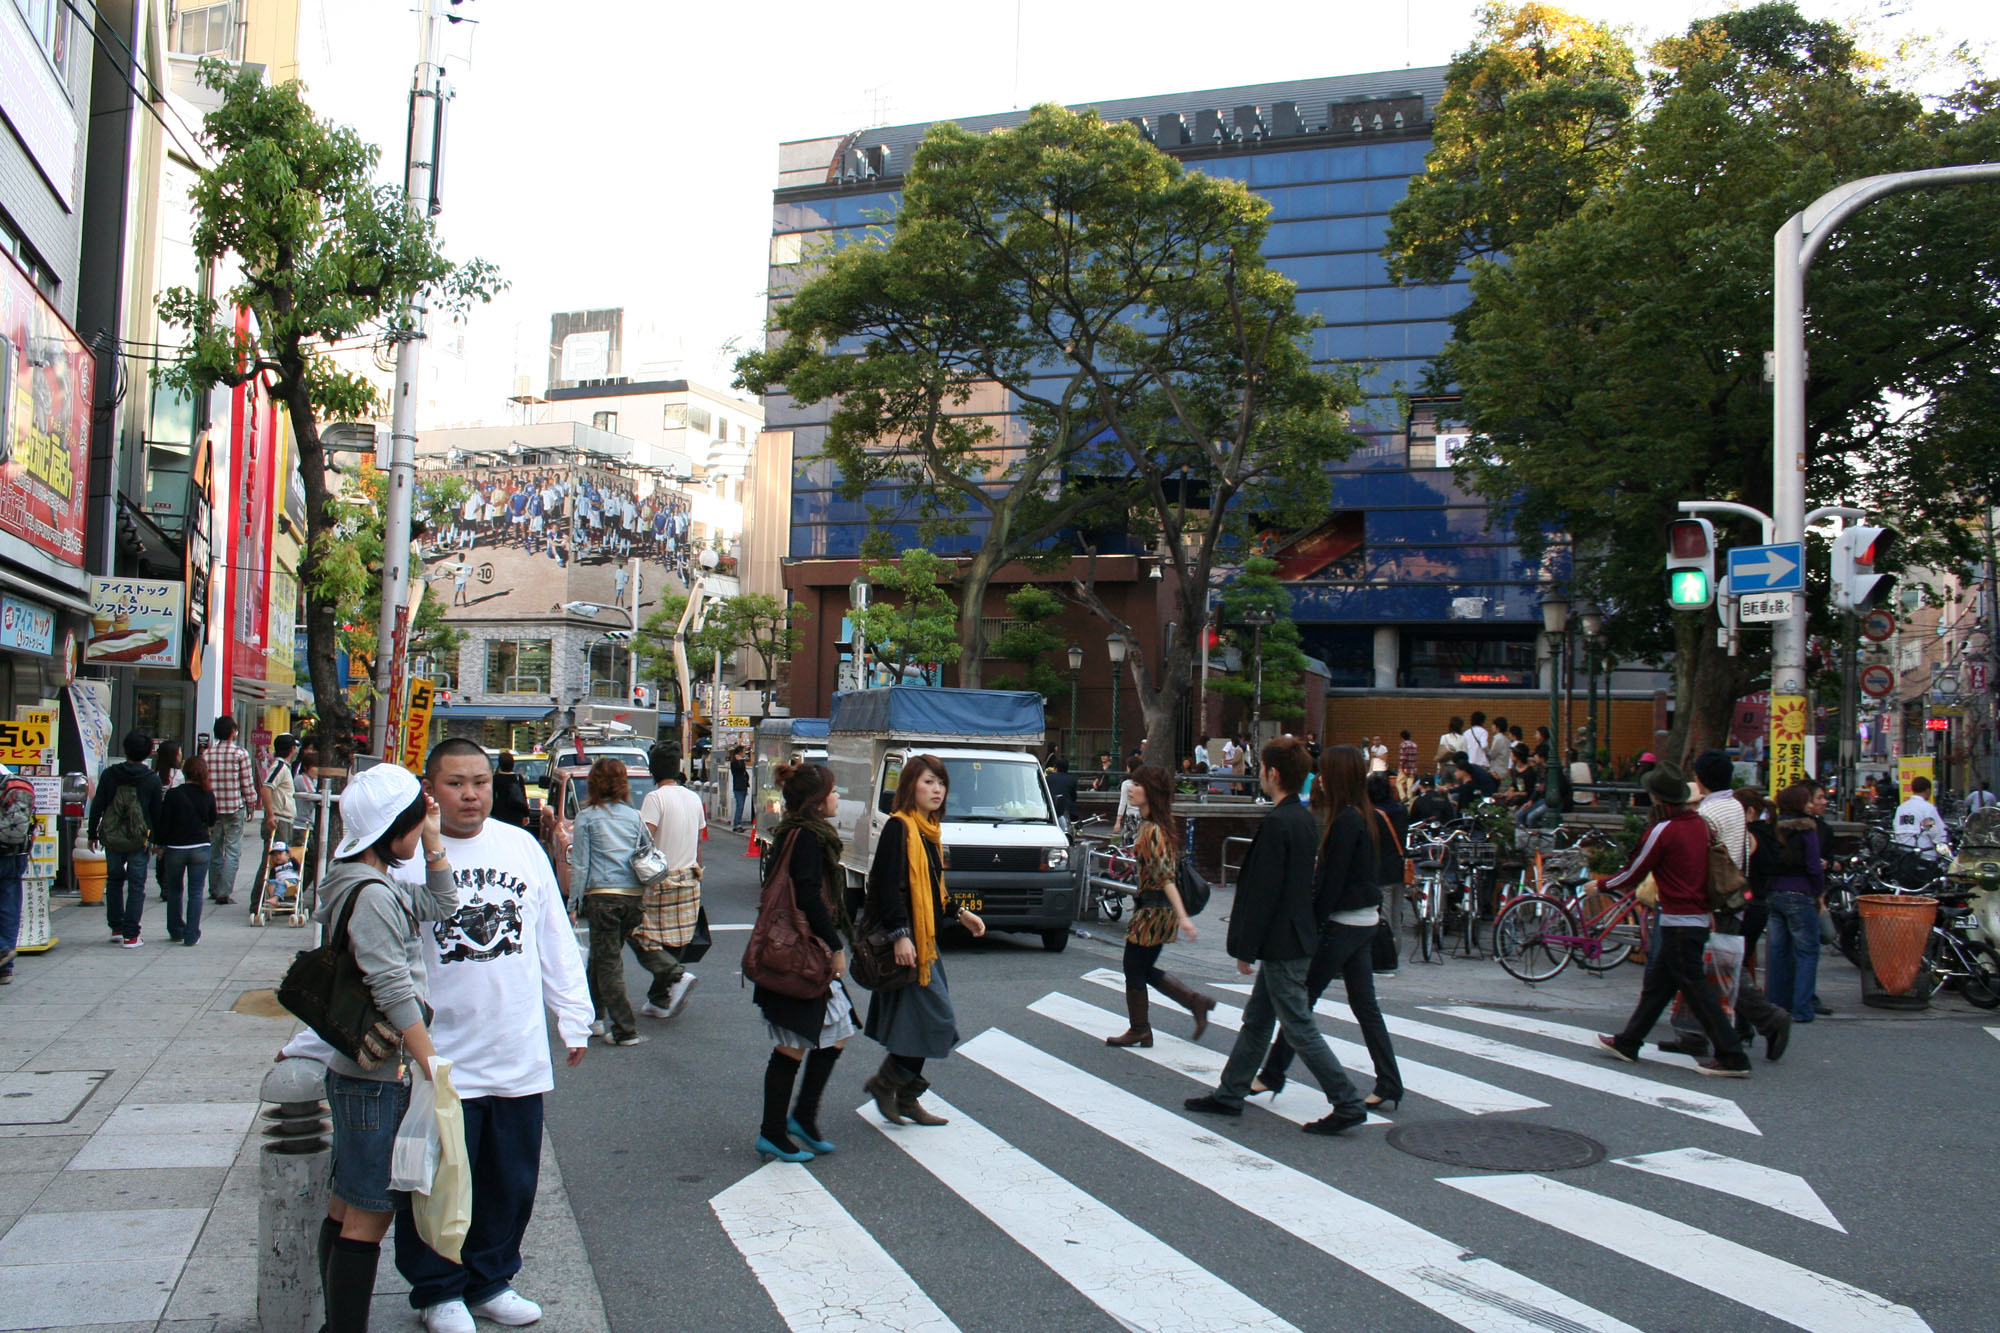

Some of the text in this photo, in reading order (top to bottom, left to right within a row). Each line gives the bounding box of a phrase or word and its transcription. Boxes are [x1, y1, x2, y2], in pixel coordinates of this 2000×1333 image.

[99, 583, 169, 597] アイスドッグ
[129, 595, 138, 604] &
[94, 602, 173, 617] ソフトクリーム
[1742, 599, 1791, 616] 自転車を除く
[1775, 743, 1787, 790] アメリカ
